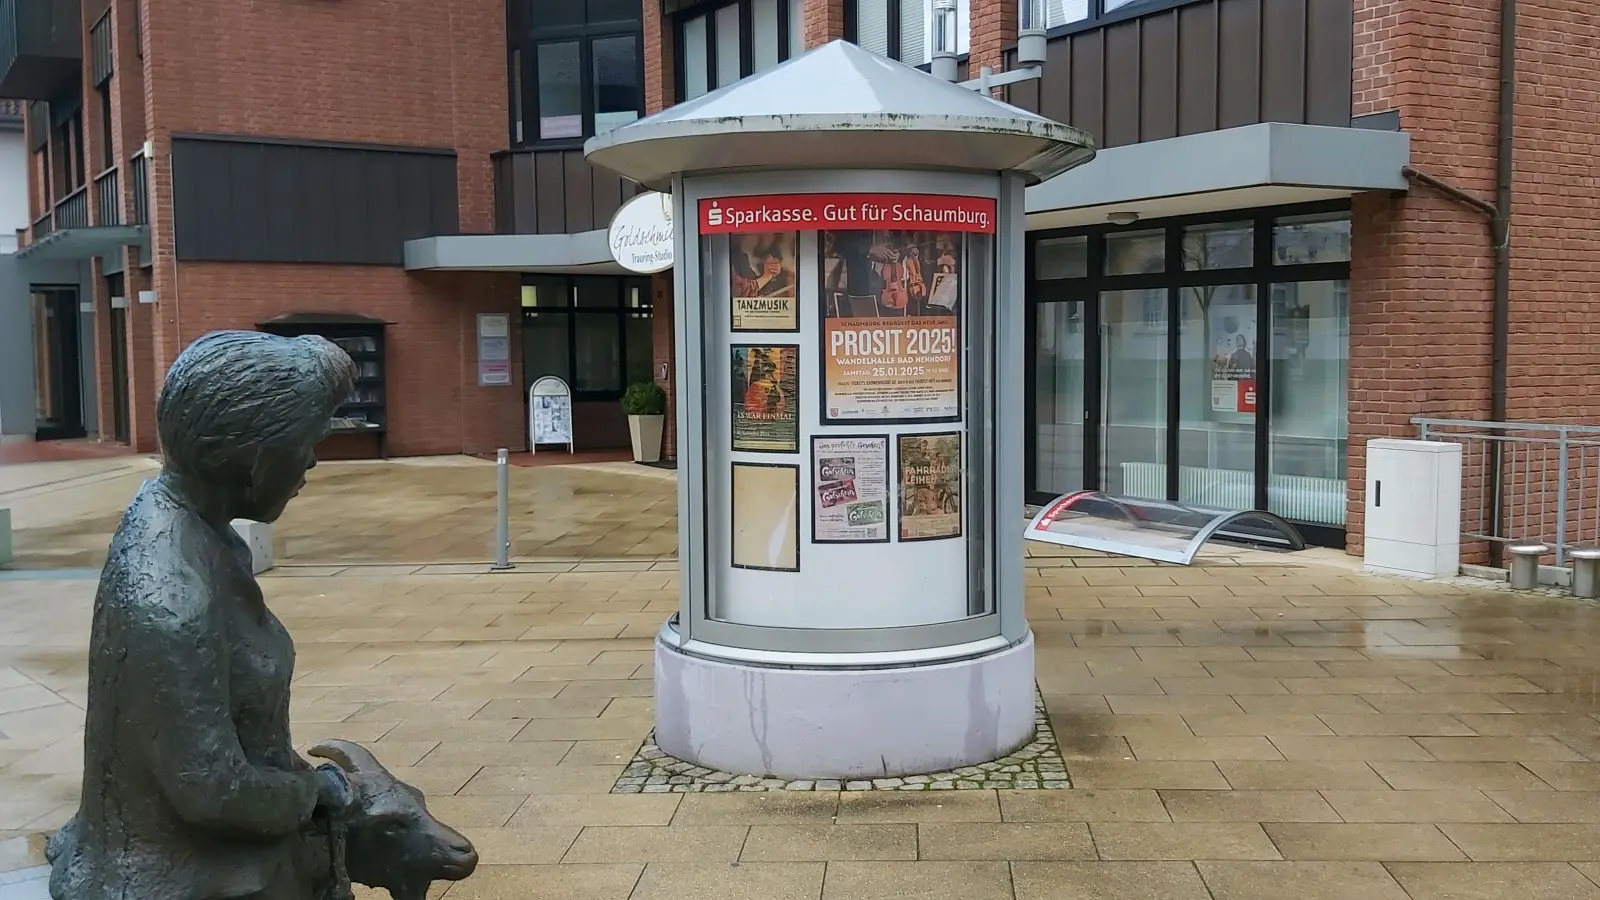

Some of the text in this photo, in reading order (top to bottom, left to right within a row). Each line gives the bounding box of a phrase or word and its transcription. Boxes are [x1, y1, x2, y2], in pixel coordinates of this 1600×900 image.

[725, 205, 818, 227] Sparkasse.
[823, 205, 857, 221] Gut
[861, 203, 889, 221] für
[892, 204, 990, 228] Schaumburg.
[632, 248, 673, 265] Trauring-Studio
[737, 300, 789, 311] TANZMUSIK
[831, 328, 956, 356] PROSIT 2025!
[836, 355, 952, 365] WANDELHALLE BAD NENNDORF
[872, 366, 925, 377] 25.01.2025
[762, 412, 793, 420] EINMAL
[821, 466, 854, 477] Gutschein
[822, 489, 855, 502] Gutschein
